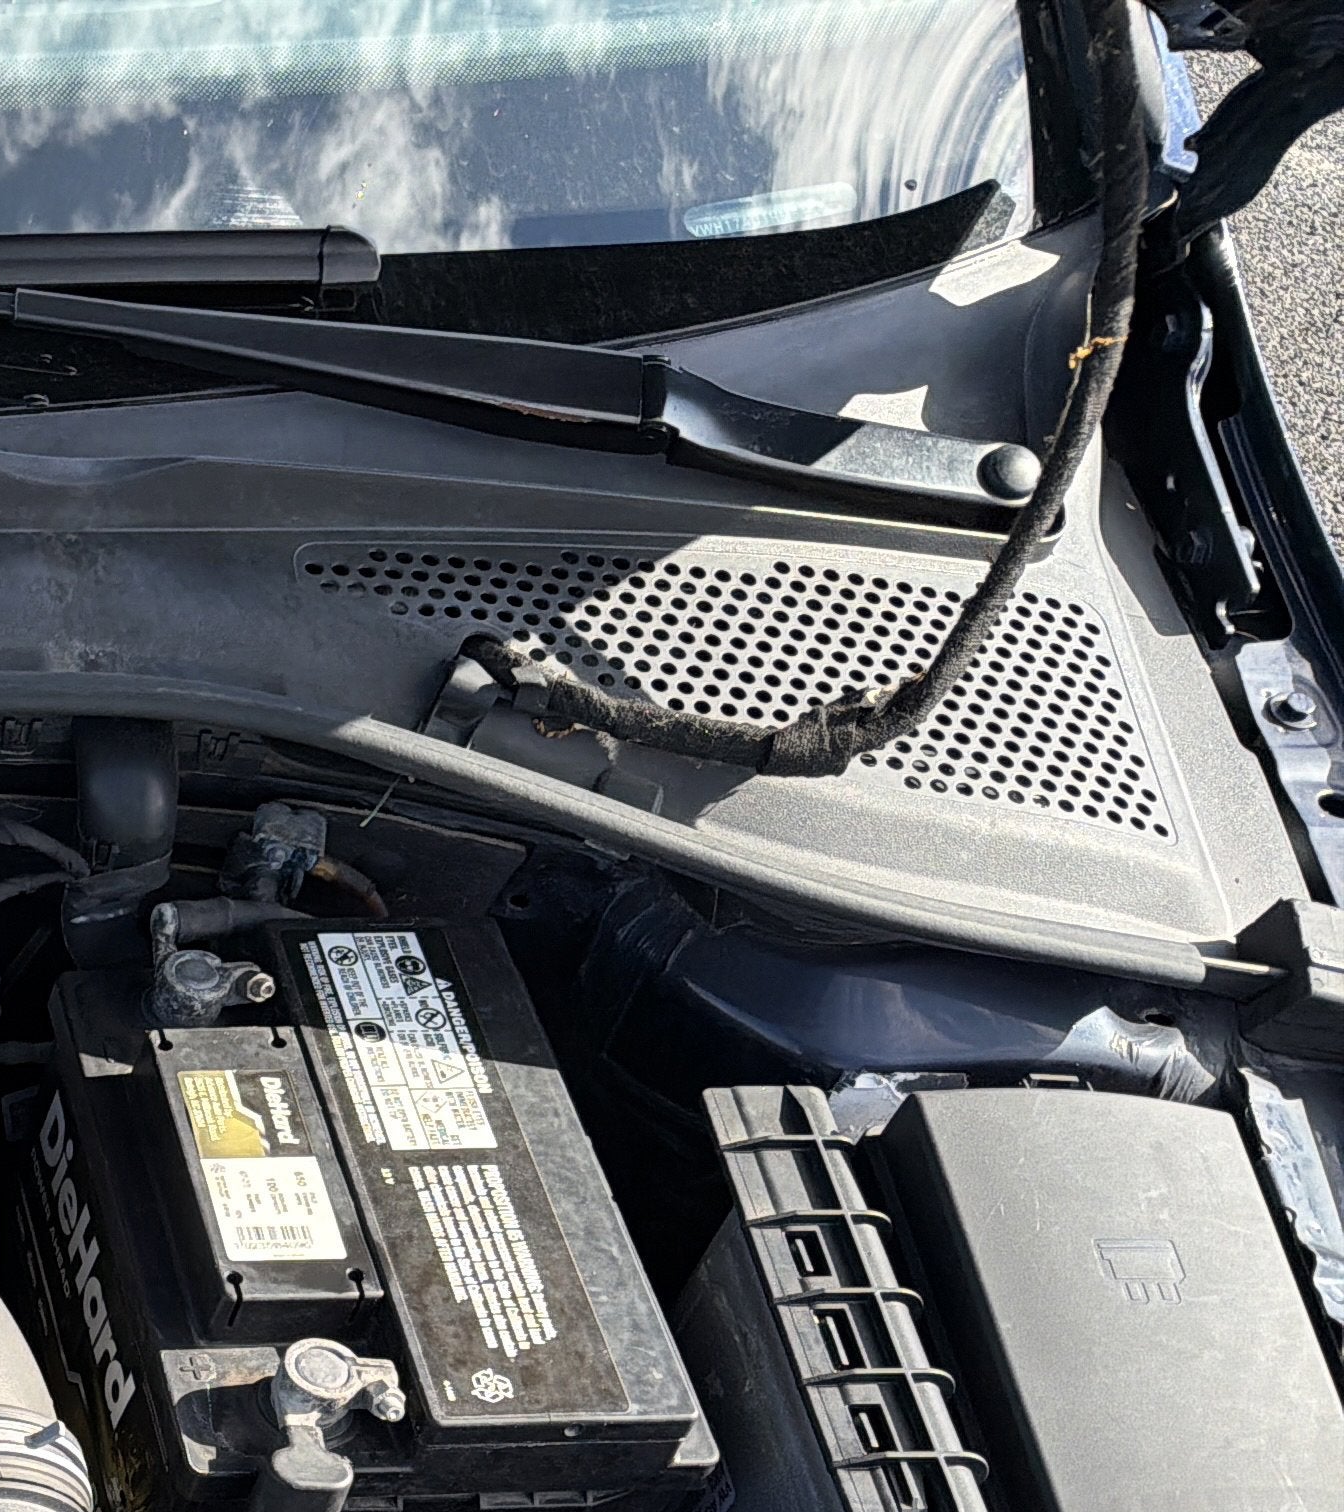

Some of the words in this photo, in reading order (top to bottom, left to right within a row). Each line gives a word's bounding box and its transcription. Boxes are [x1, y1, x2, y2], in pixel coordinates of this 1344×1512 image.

[260, 1077, 300, 1144] DieHard
[481, 1165, 521, 1228] PROPOSITION
[39, 1088, 136, 1431] DieHard
